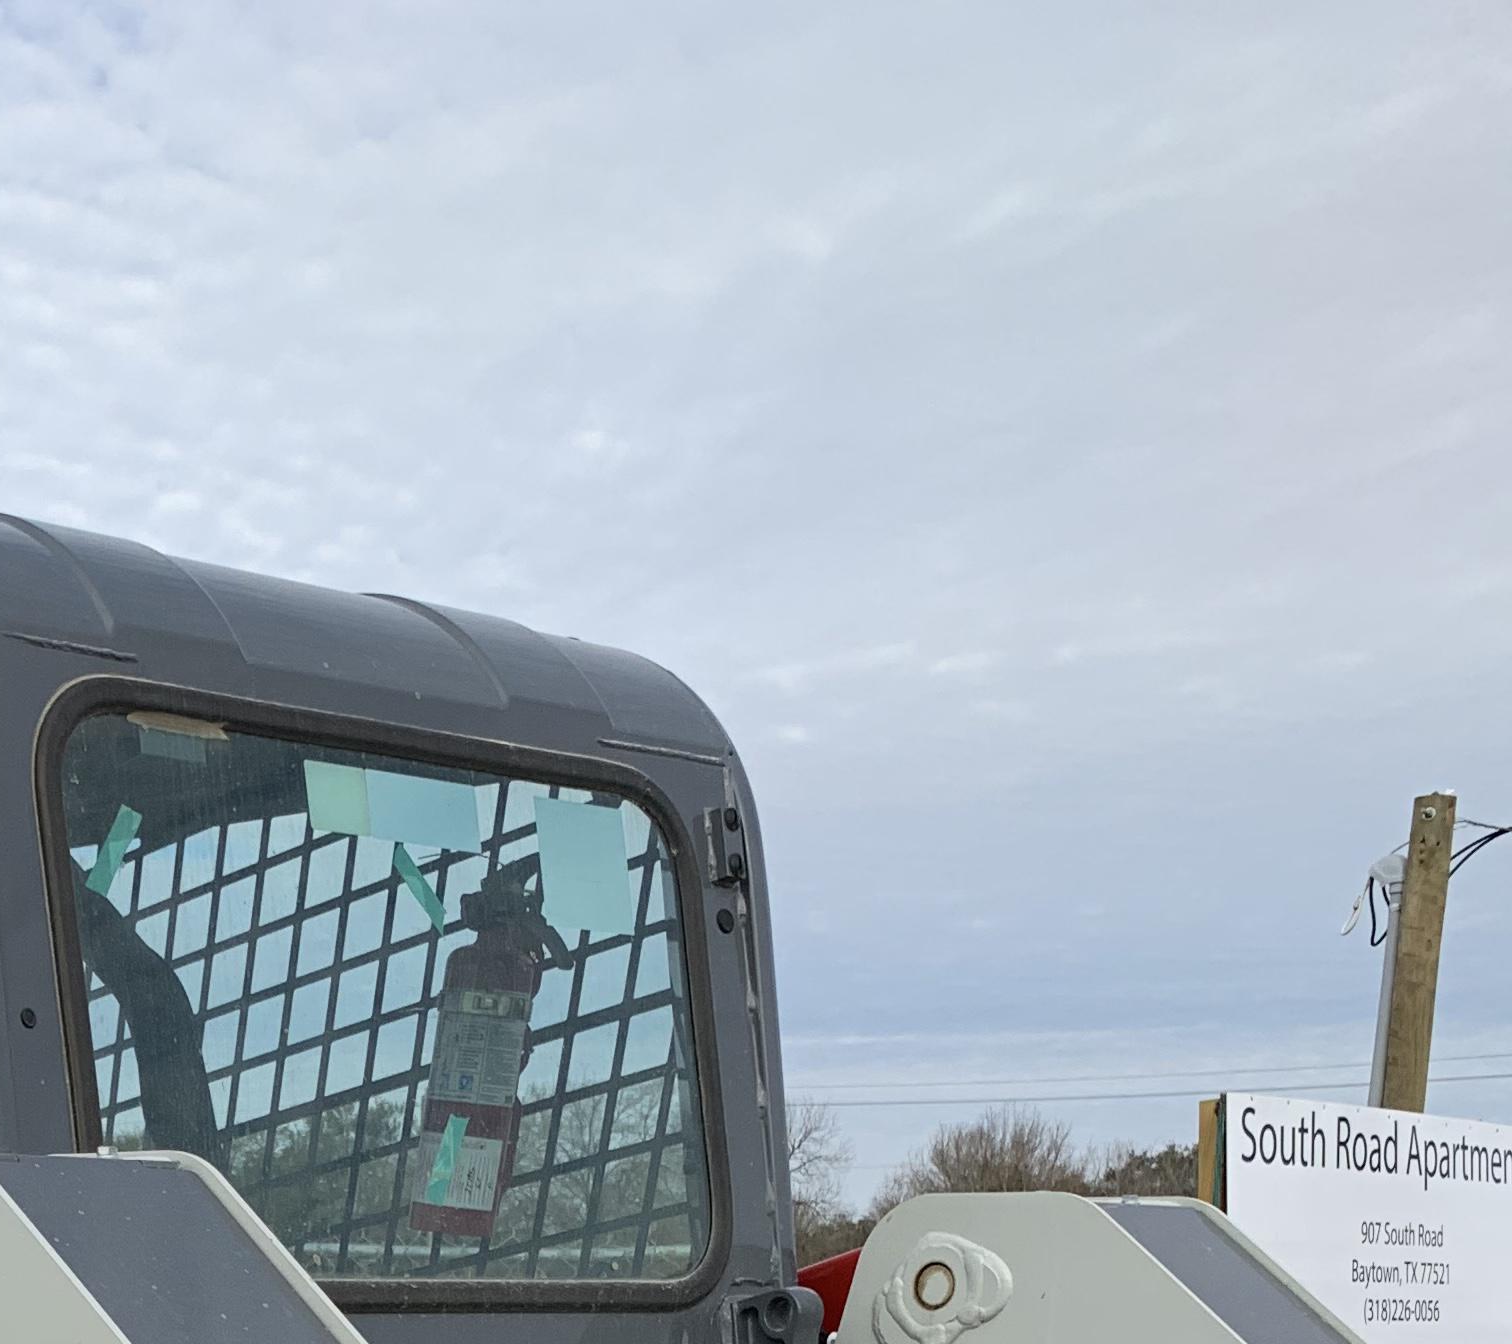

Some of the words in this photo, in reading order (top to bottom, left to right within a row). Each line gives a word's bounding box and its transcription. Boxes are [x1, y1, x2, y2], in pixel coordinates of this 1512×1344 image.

[1241, 1106, 1326, 1168] South
[1336, 1116, 1398, 1175] Road
[1361, 1221, 1382, 1244] 907
[1384, 1221, 1415, 1246] South
[1418, 1223, 1444, 1248] Road
[1352, 1258, 1402, 1289] Baytown,
[1403, 1260, 1418, 1284] TX
[1420, 1262, 1450, 1285] 77521
[1364, 1297, 1440, 1326] (318)226-0056
